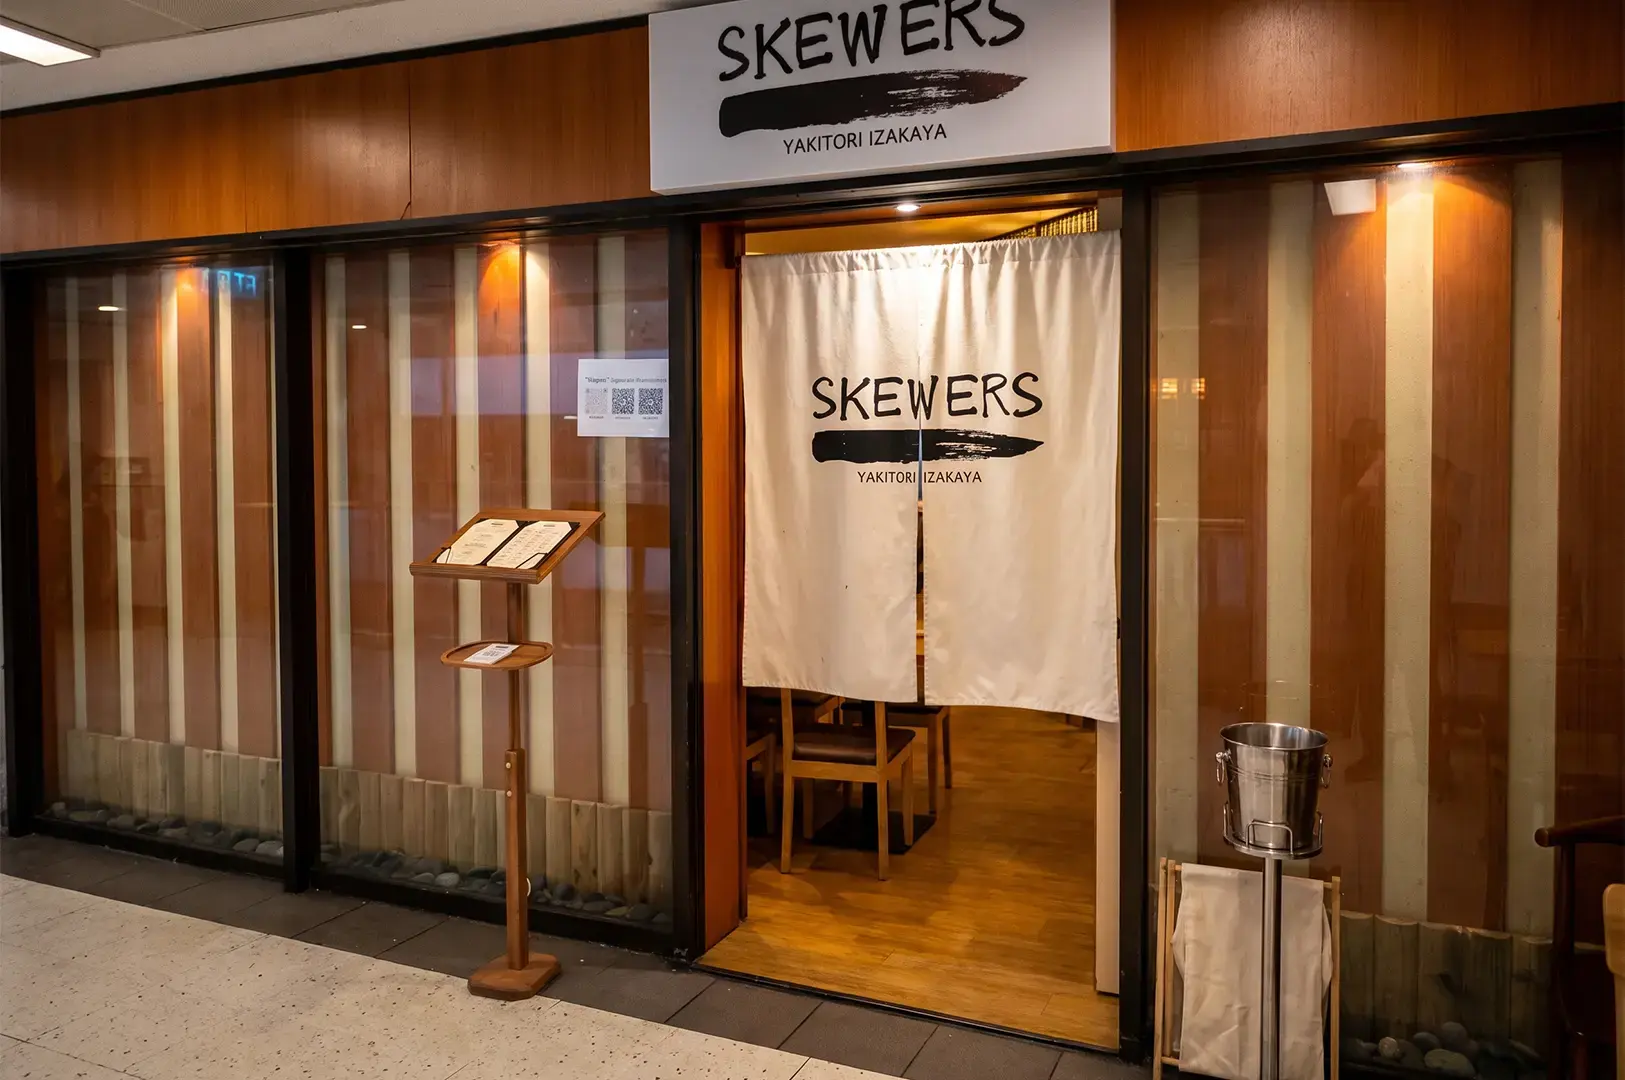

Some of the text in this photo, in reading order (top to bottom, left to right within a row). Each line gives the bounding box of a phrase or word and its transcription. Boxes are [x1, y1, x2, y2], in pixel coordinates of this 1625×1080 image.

[718, 0, 1026, 82] SKEWERS
[783, 123, 948, 155] YAKITORI IZAKAYA
[811, 371, 1043, 422] SKEWERS
[857, 471, 983, 484] YAKITORI IZAKAYA
